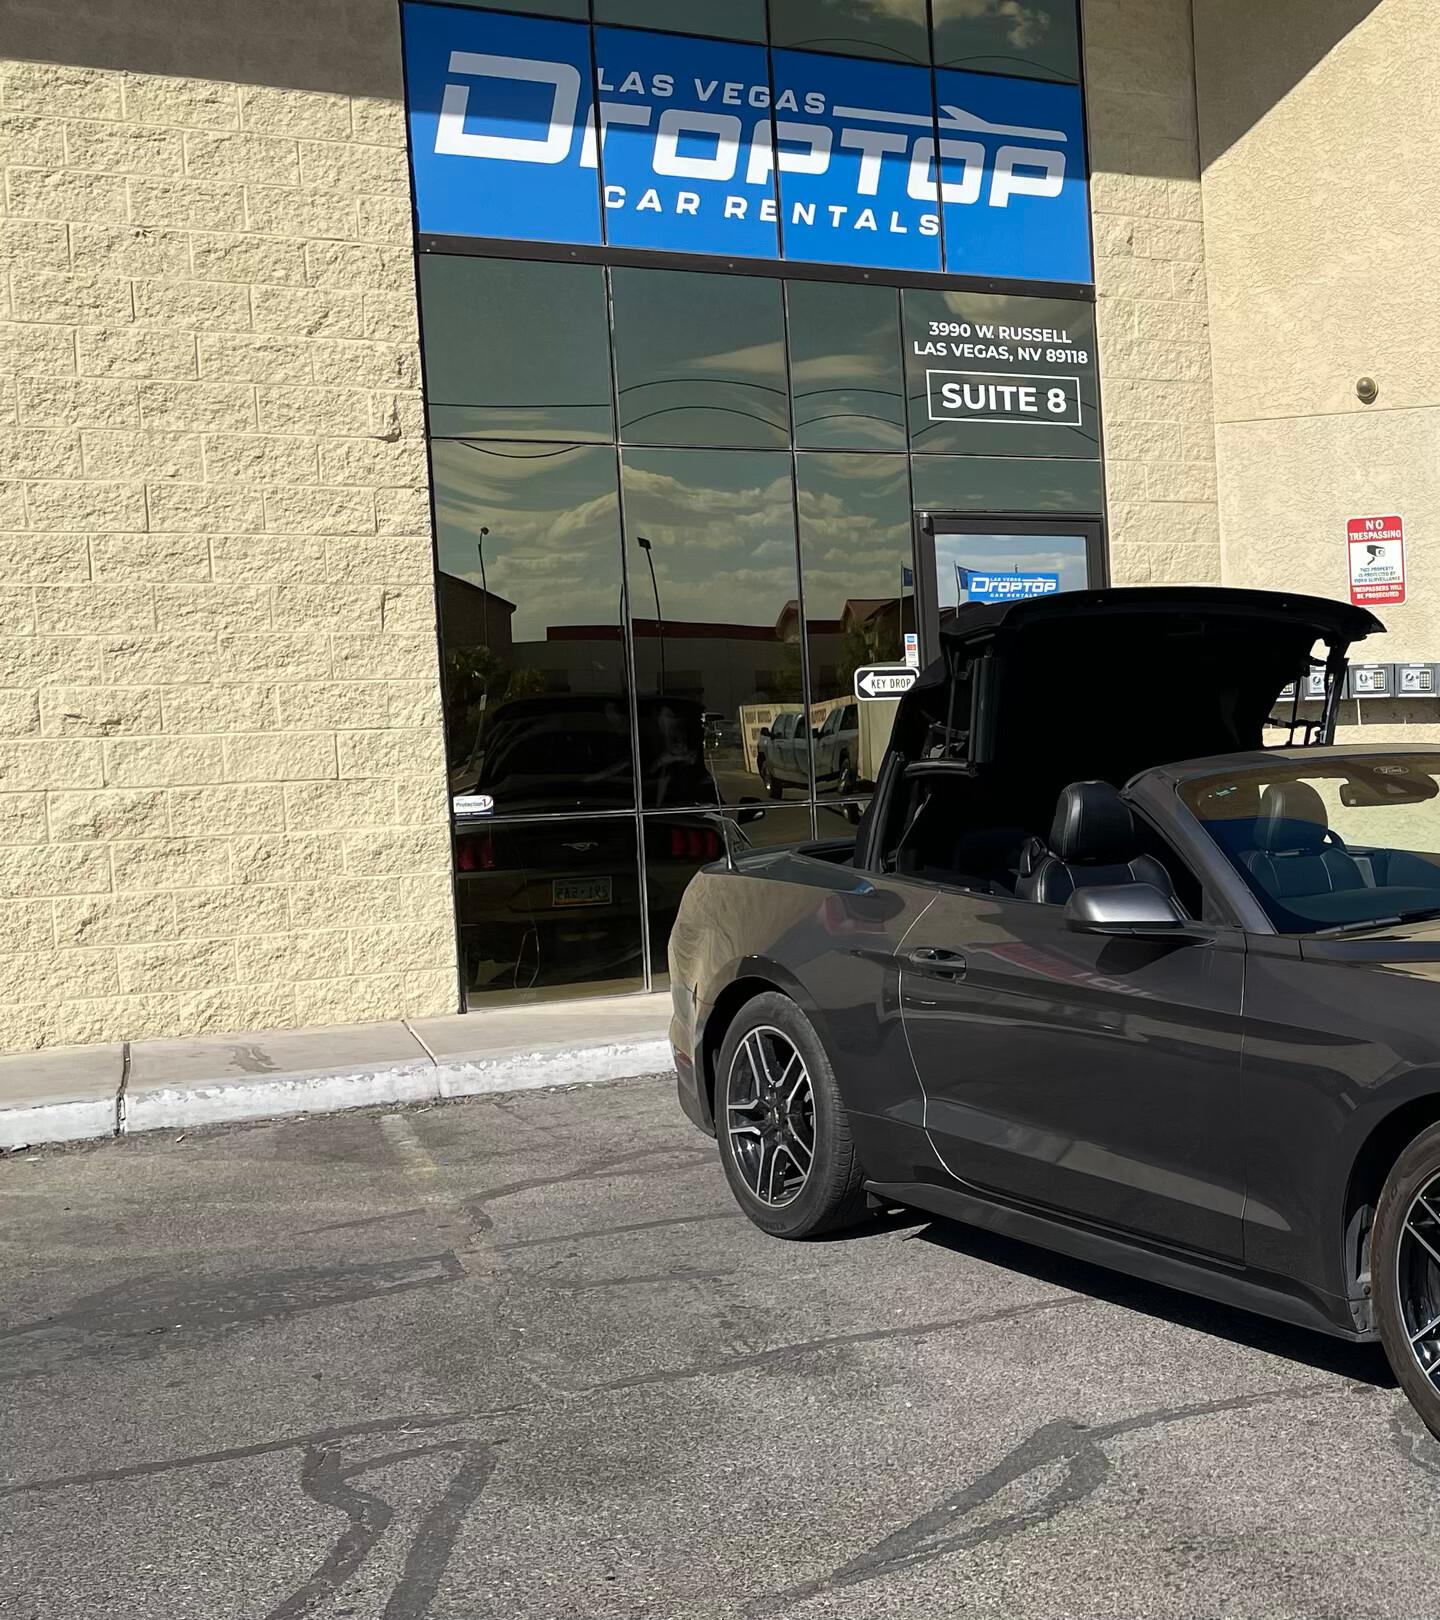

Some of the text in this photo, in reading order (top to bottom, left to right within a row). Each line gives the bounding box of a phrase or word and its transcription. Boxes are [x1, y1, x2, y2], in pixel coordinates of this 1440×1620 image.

[597, 67, 826, 114] LAS VEGAS
[604, 186, 940, 236] CAR RENTALS
[929, 321, 971, 337] 3990
[999, 326, 1072, 343] RUSSELL
[914, 341, 1088, 364] LAS VEGAS, NV 89118
[941, 383, 1067, 413] SUITE 8
[1349, 530, 1401, 540] TRESPASSING
[1365, 519, 1384, 530] NO
[871, 678, 911, 689] KEY DROP
